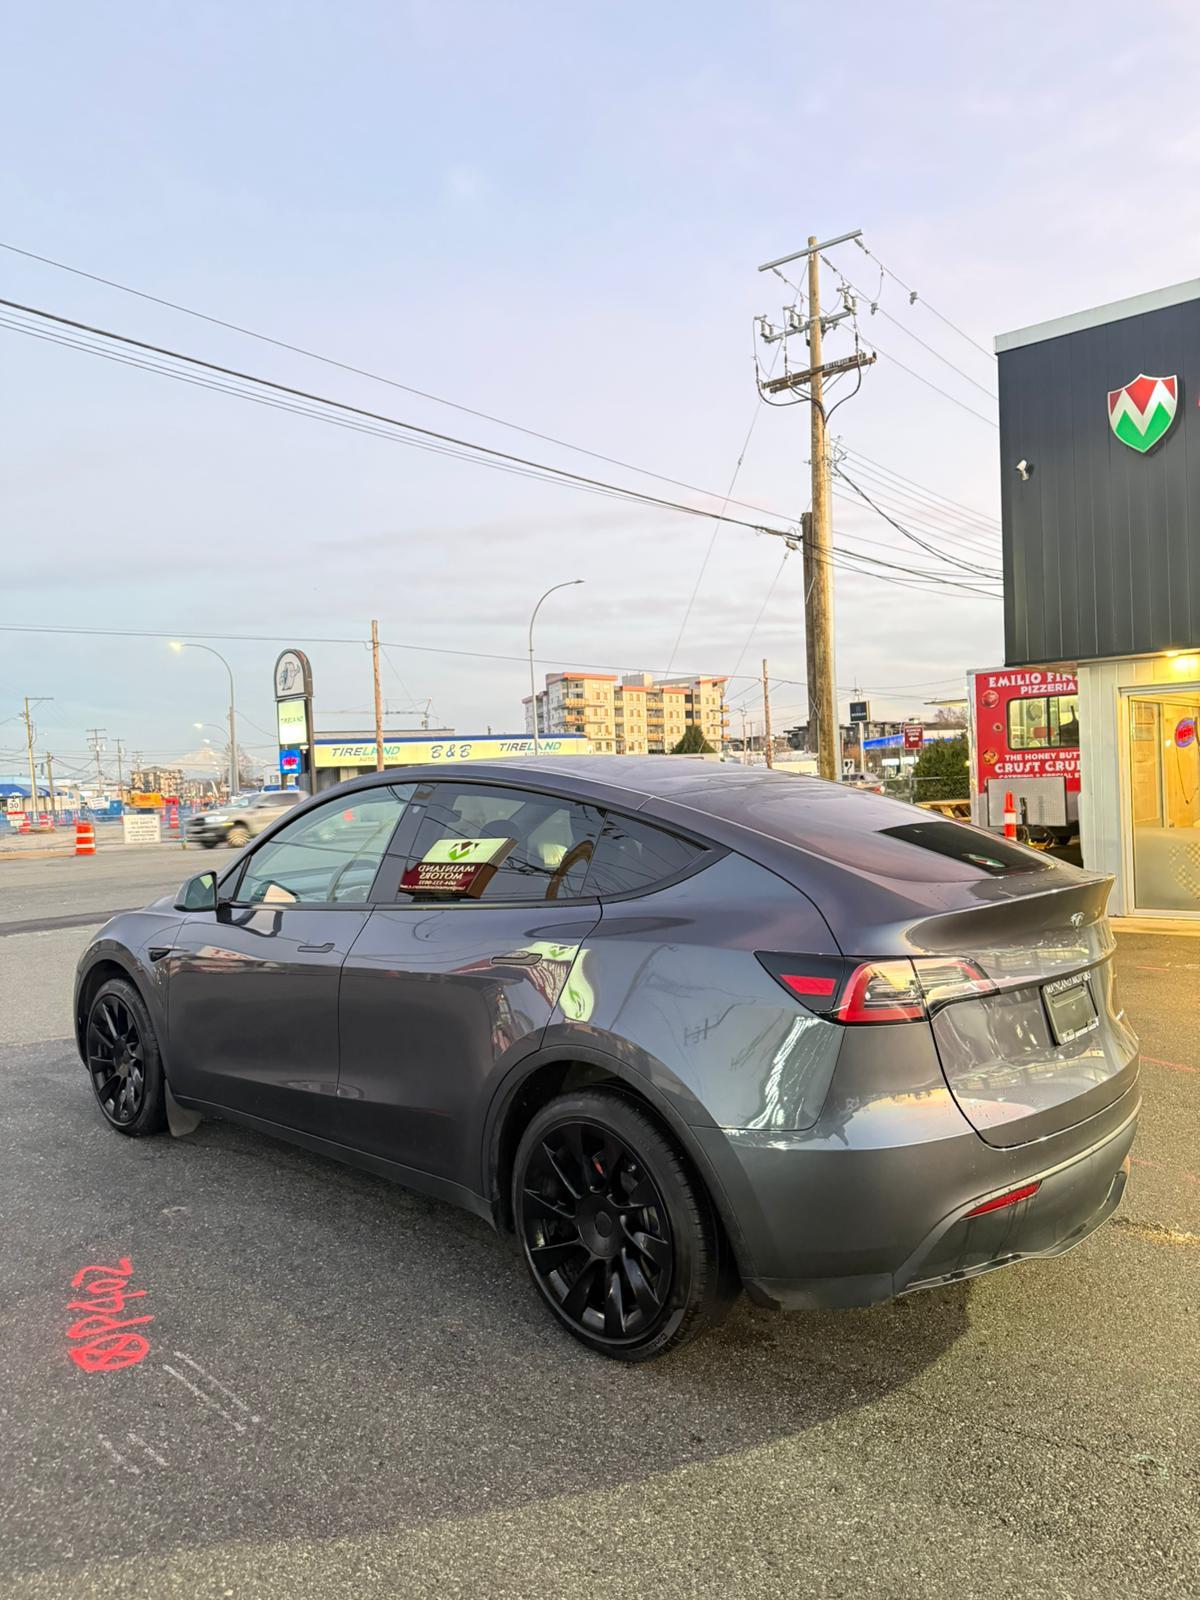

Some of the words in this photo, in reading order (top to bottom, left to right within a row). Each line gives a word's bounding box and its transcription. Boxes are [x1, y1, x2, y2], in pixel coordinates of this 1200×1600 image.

[989, 673, 1041, 688] EMILIO
[1020, 682, 1076, 695] PIZZERIA
[431, 745, 443, 759] B
[446, 744, 456, 758] &
[460, 744, 472, 758] B
[1024, 752, 1057, 760] HONEY
[994, 761, 1040, 773] CRUST
